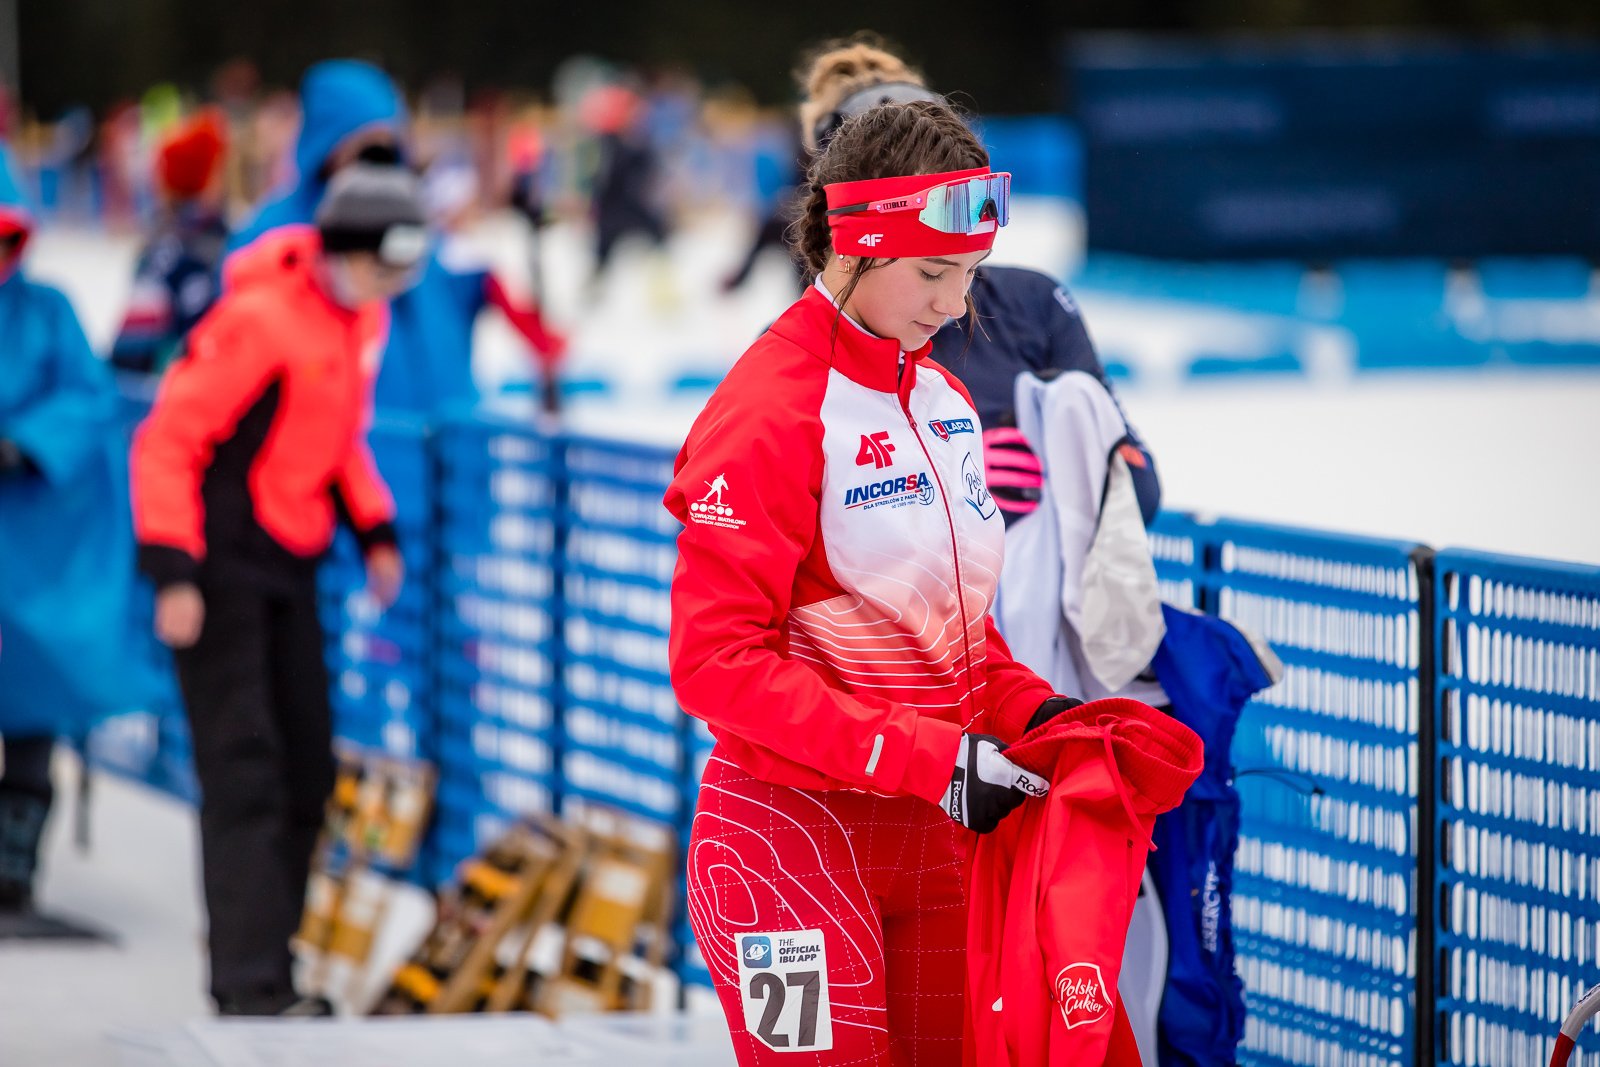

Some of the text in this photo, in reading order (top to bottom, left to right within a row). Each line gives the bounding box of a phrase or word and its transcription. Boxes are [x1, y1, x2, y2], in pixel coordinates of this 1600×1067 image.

[857, 233, 883, 246] 4F
[944, 421, 973, 431] LAPUA
[855, 430, 895, 469] 4F
[844, 472, 929, 505] INCORSA
[778, 938, 794, 946] THE
[779, 944, 820, 954] OFFICIAL
[796, 953, 816, 962] APP
[1058, 977, 1098, 1000] Polski
[749, 970, 820, 1047] 27
[1065, 994, 1103, 1014] Cukier
